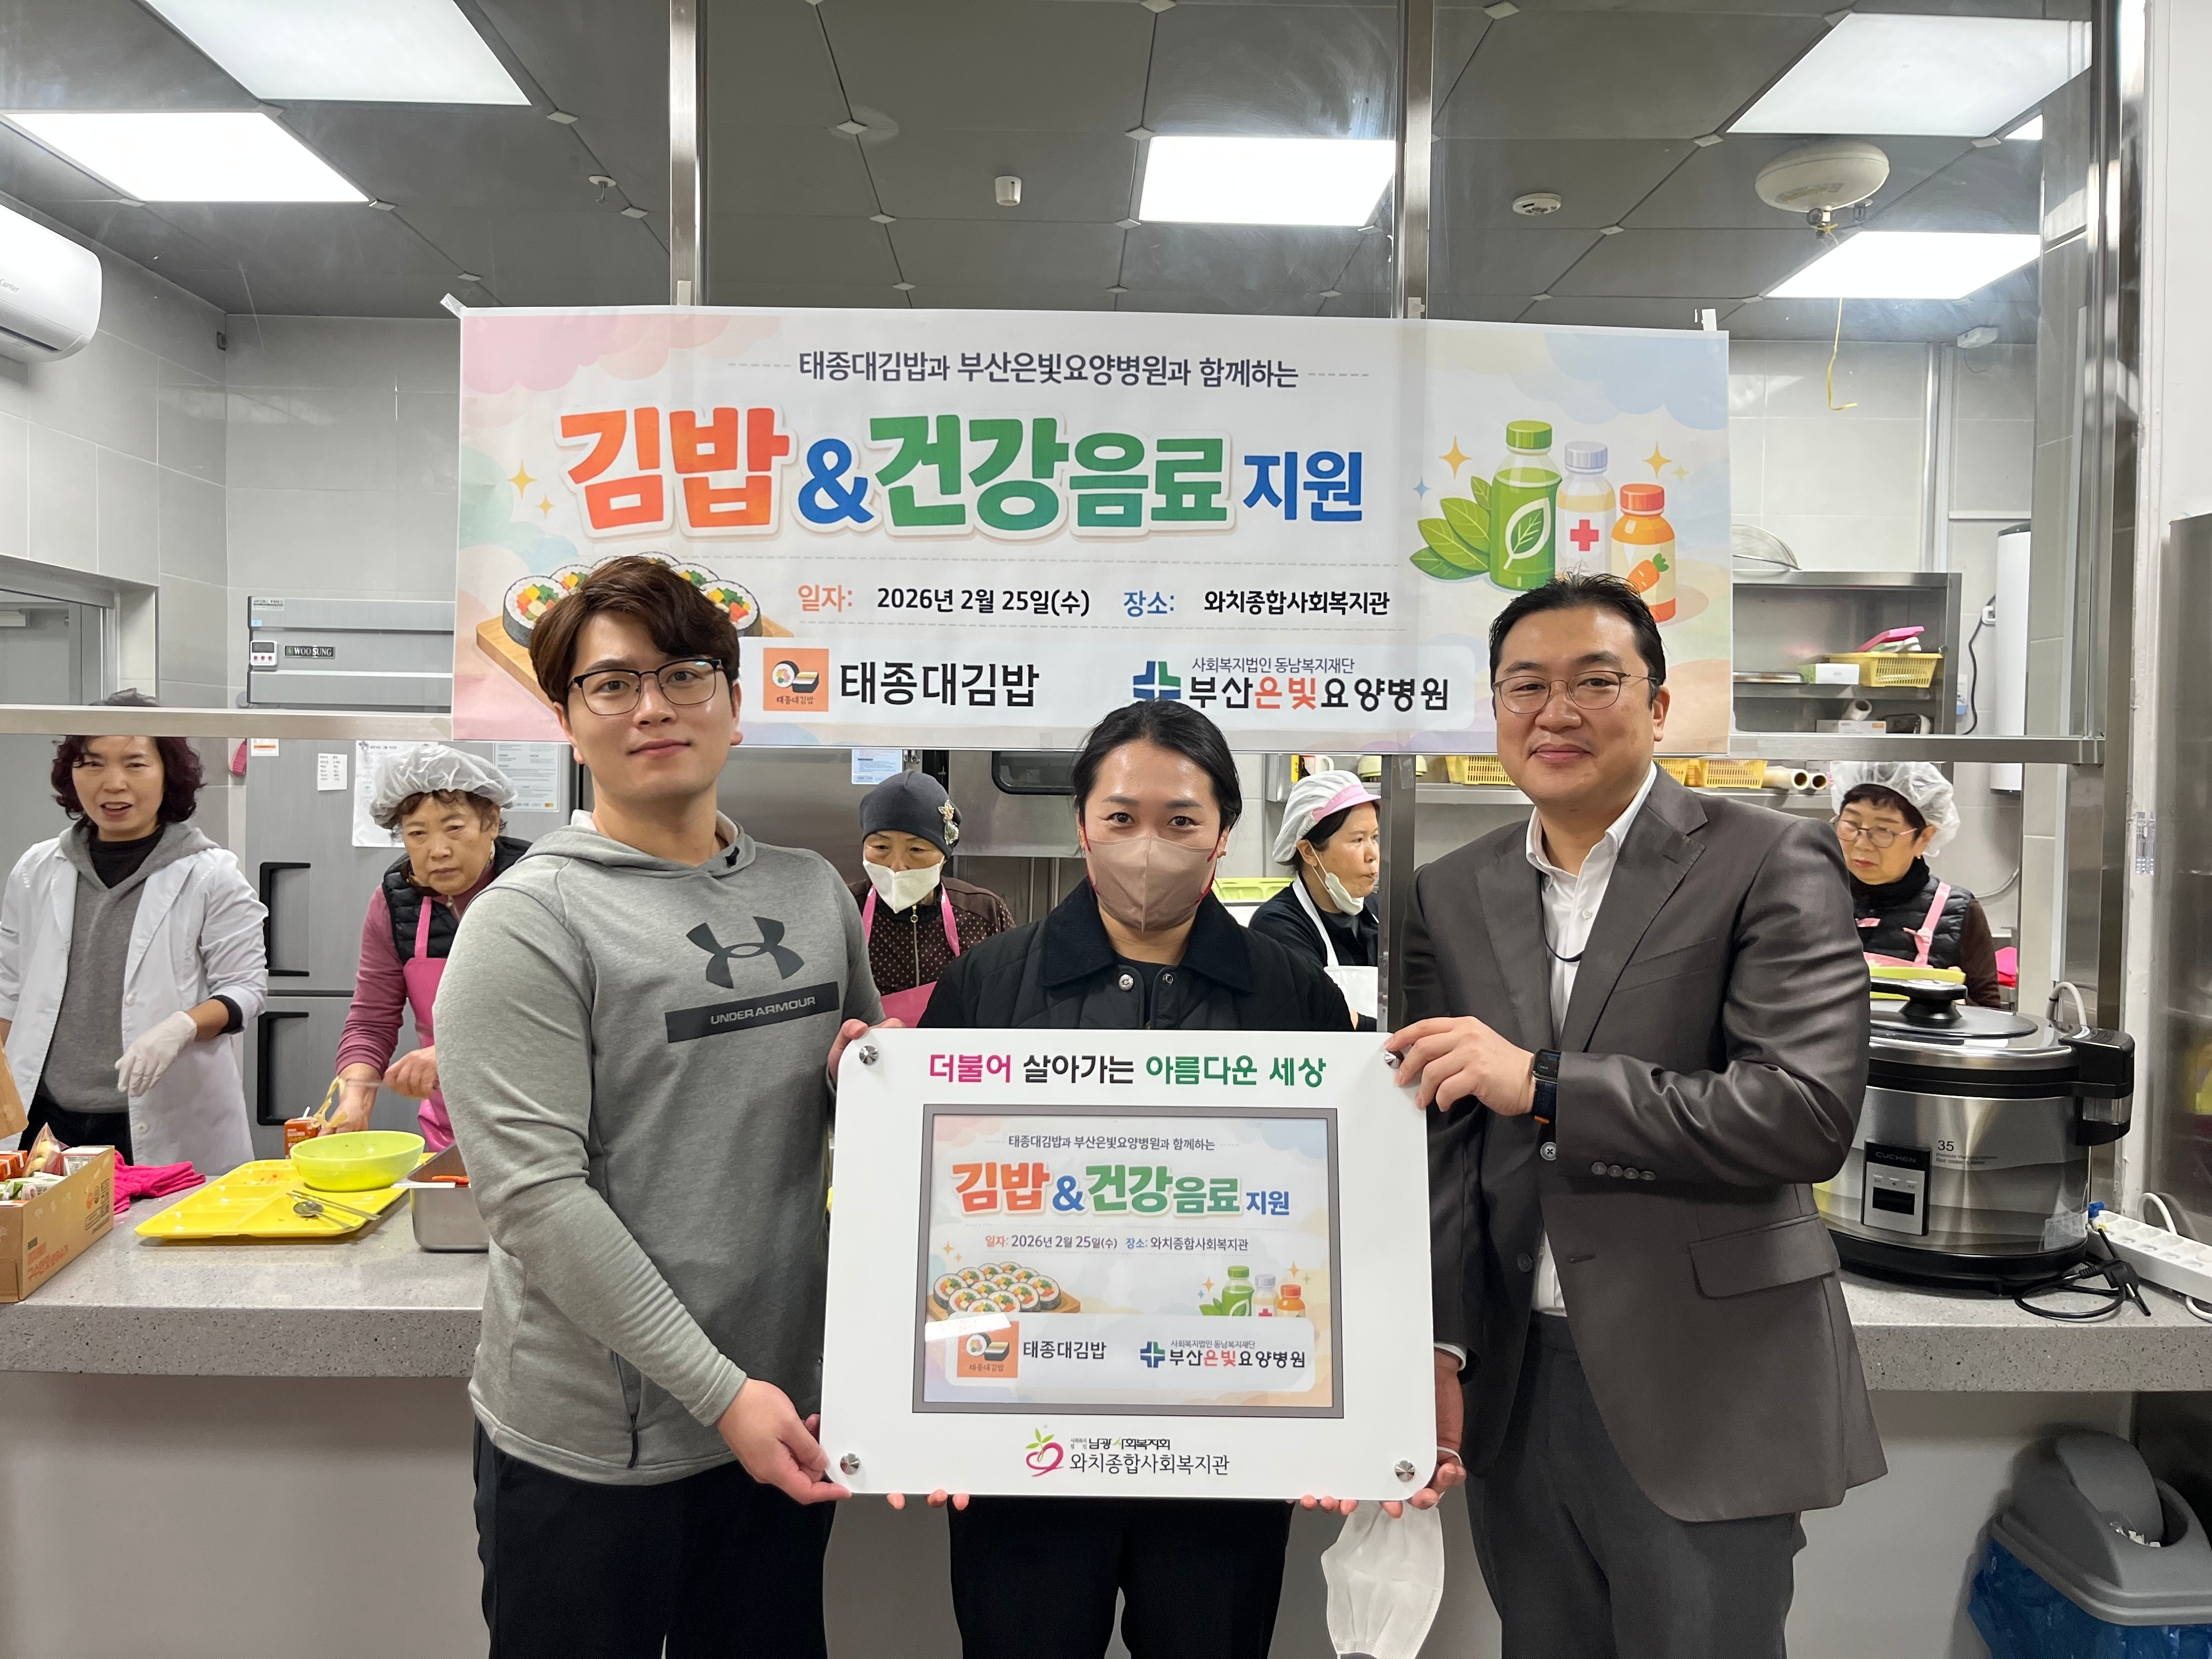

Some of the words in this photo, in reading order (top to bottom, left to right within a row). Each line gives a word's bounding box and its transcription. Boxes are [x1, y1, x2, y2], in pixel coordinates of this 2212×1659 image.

[0, 278, 20, 292] Carrier
[799, 351, 951, 382] 태종대김밥과
[957, 352, 1192, 386] 부산은빛요양병원과
[1199, 357, 1299, 388] 함께하는
[1243, 450, 1363, 522] 지원
[798, 584, 853, 613] 일자:
[877, 588, 953, 613] 2026년
[961, 589, 994, 614] 2월
[1002, 589, 1090, 617] 25일(수)
[1124, 590, 1175, 617] 장소:
[1204, 590, 1390, 616] 와치종합사회복지관
[294, 647, 312, 656] WOO
[312, 647, 332, 656] SUNG
[1192, 657, 1271, 673] 사회복지법인
[1274, 657, 1356, 674] 동남복지재단
[840, 661, 1040, 707] 태종대김밥
[1189, 676, 1448, 712] 부산은빛요양병원
[929, 1054, 1011, 1083] 더불어
[1023, 1054, 1134, 1084] 살아가는
[1146, 1055, 1257, 1086] 아름다운
[1269, 1057, 1327, 1088] 세상
[1008, 1135, 1071, 1148] 태종대김밥과
[1074, 1136, 1170, 1150] 부산은빛요양병원과
[1172, 1137, 1215, 1151] 함께하는
[1937, 1139, 1954, 1151] 35
[1246, 1190, 1290, 1216] 지원
[985, 1235, 1009, 1248] 일자:
[1011, 1234, 1052, 1248] 2026년
[1055, 1235, 1073, 1248] 2월
[1076, 1235, 1118, 1249] 25일(수)
[1125, 1237, 1148, 1249] 장소:
[1150, 1237, 1249, 1251] 와치종합사회복지관
[1023, 1340, 1107, 1359] 태종대김밥
[1170, 1339, 1212, 1348] 사회복지법인
[1214, 1340, 1256, 1350] 동남복지재단
[1169, 1349, 1305, 1369] 부산은빛요양병원
[1069, 1452, 1230, 1475] 와치종합사회복지관
